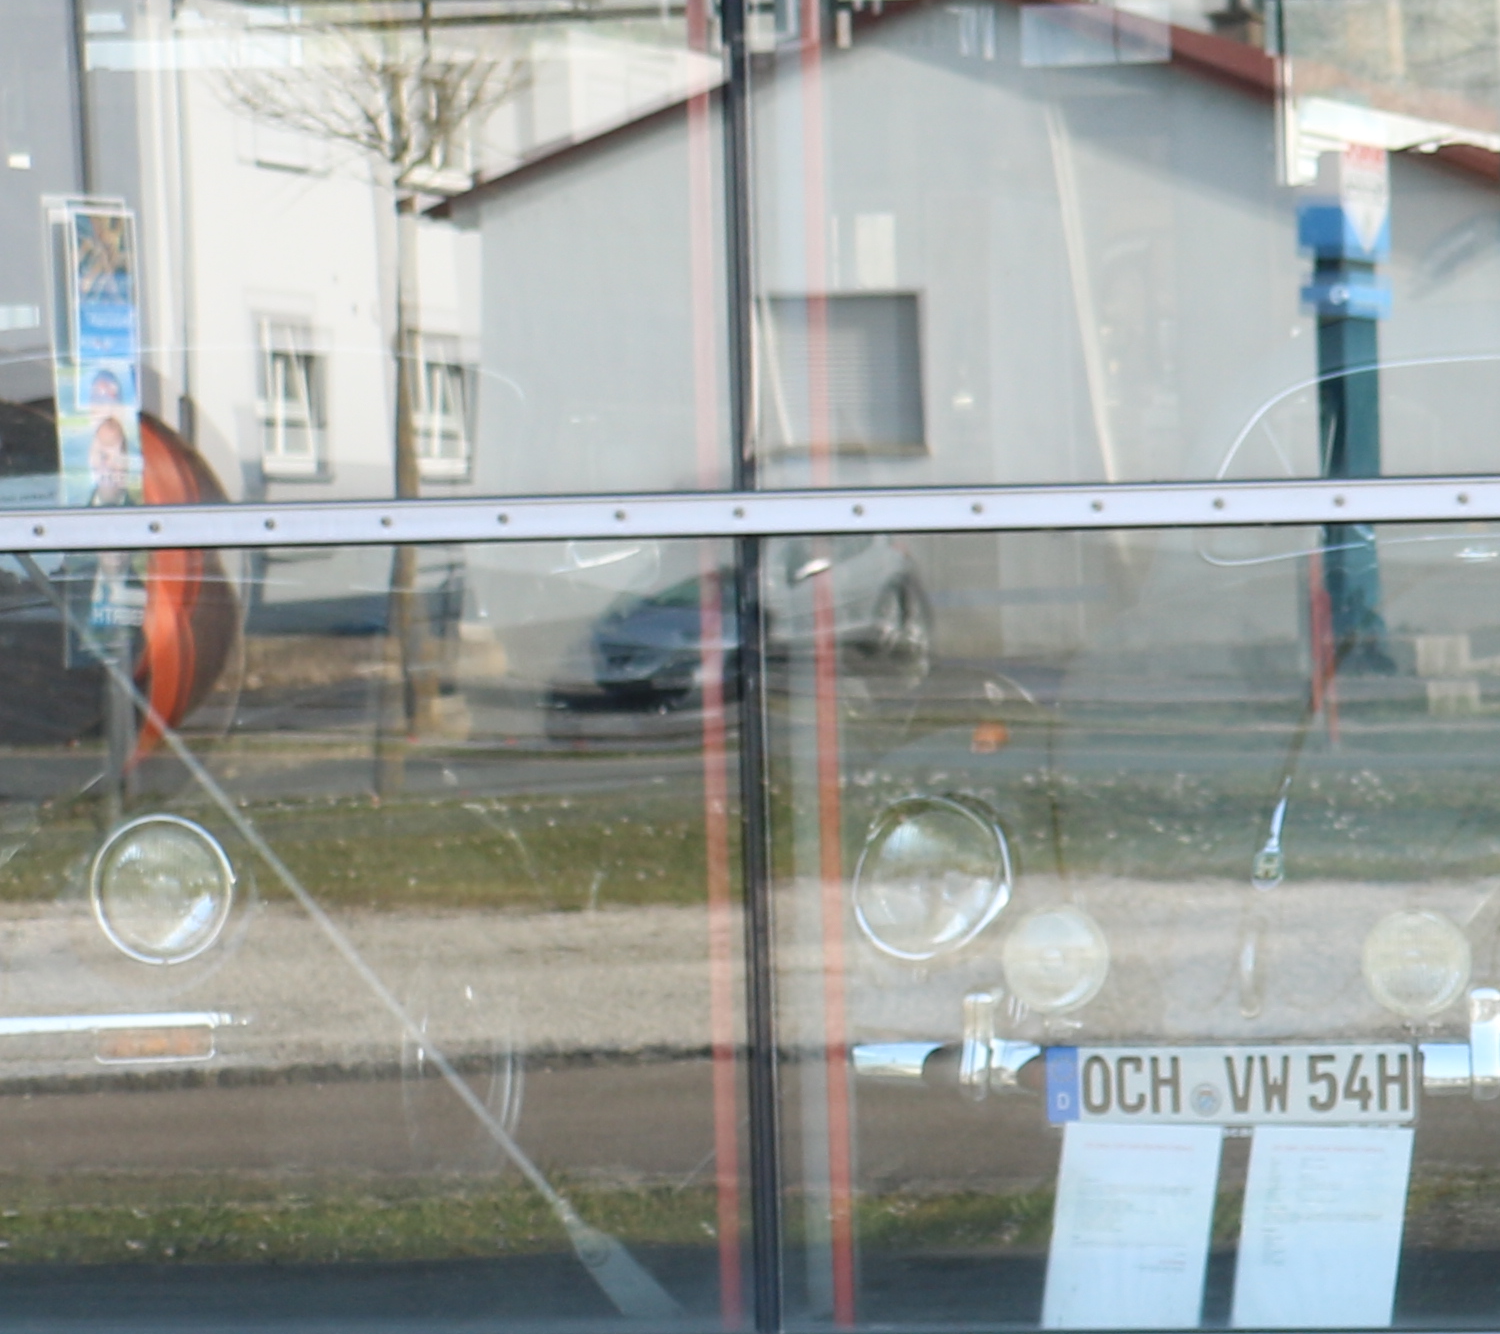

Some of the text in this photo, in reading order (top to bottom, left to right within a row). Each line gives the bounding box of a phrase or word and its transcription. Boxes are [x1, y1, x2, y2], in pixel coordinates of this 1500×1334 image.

[1081, 1052, 1411, 1115] OCH VW 54H
